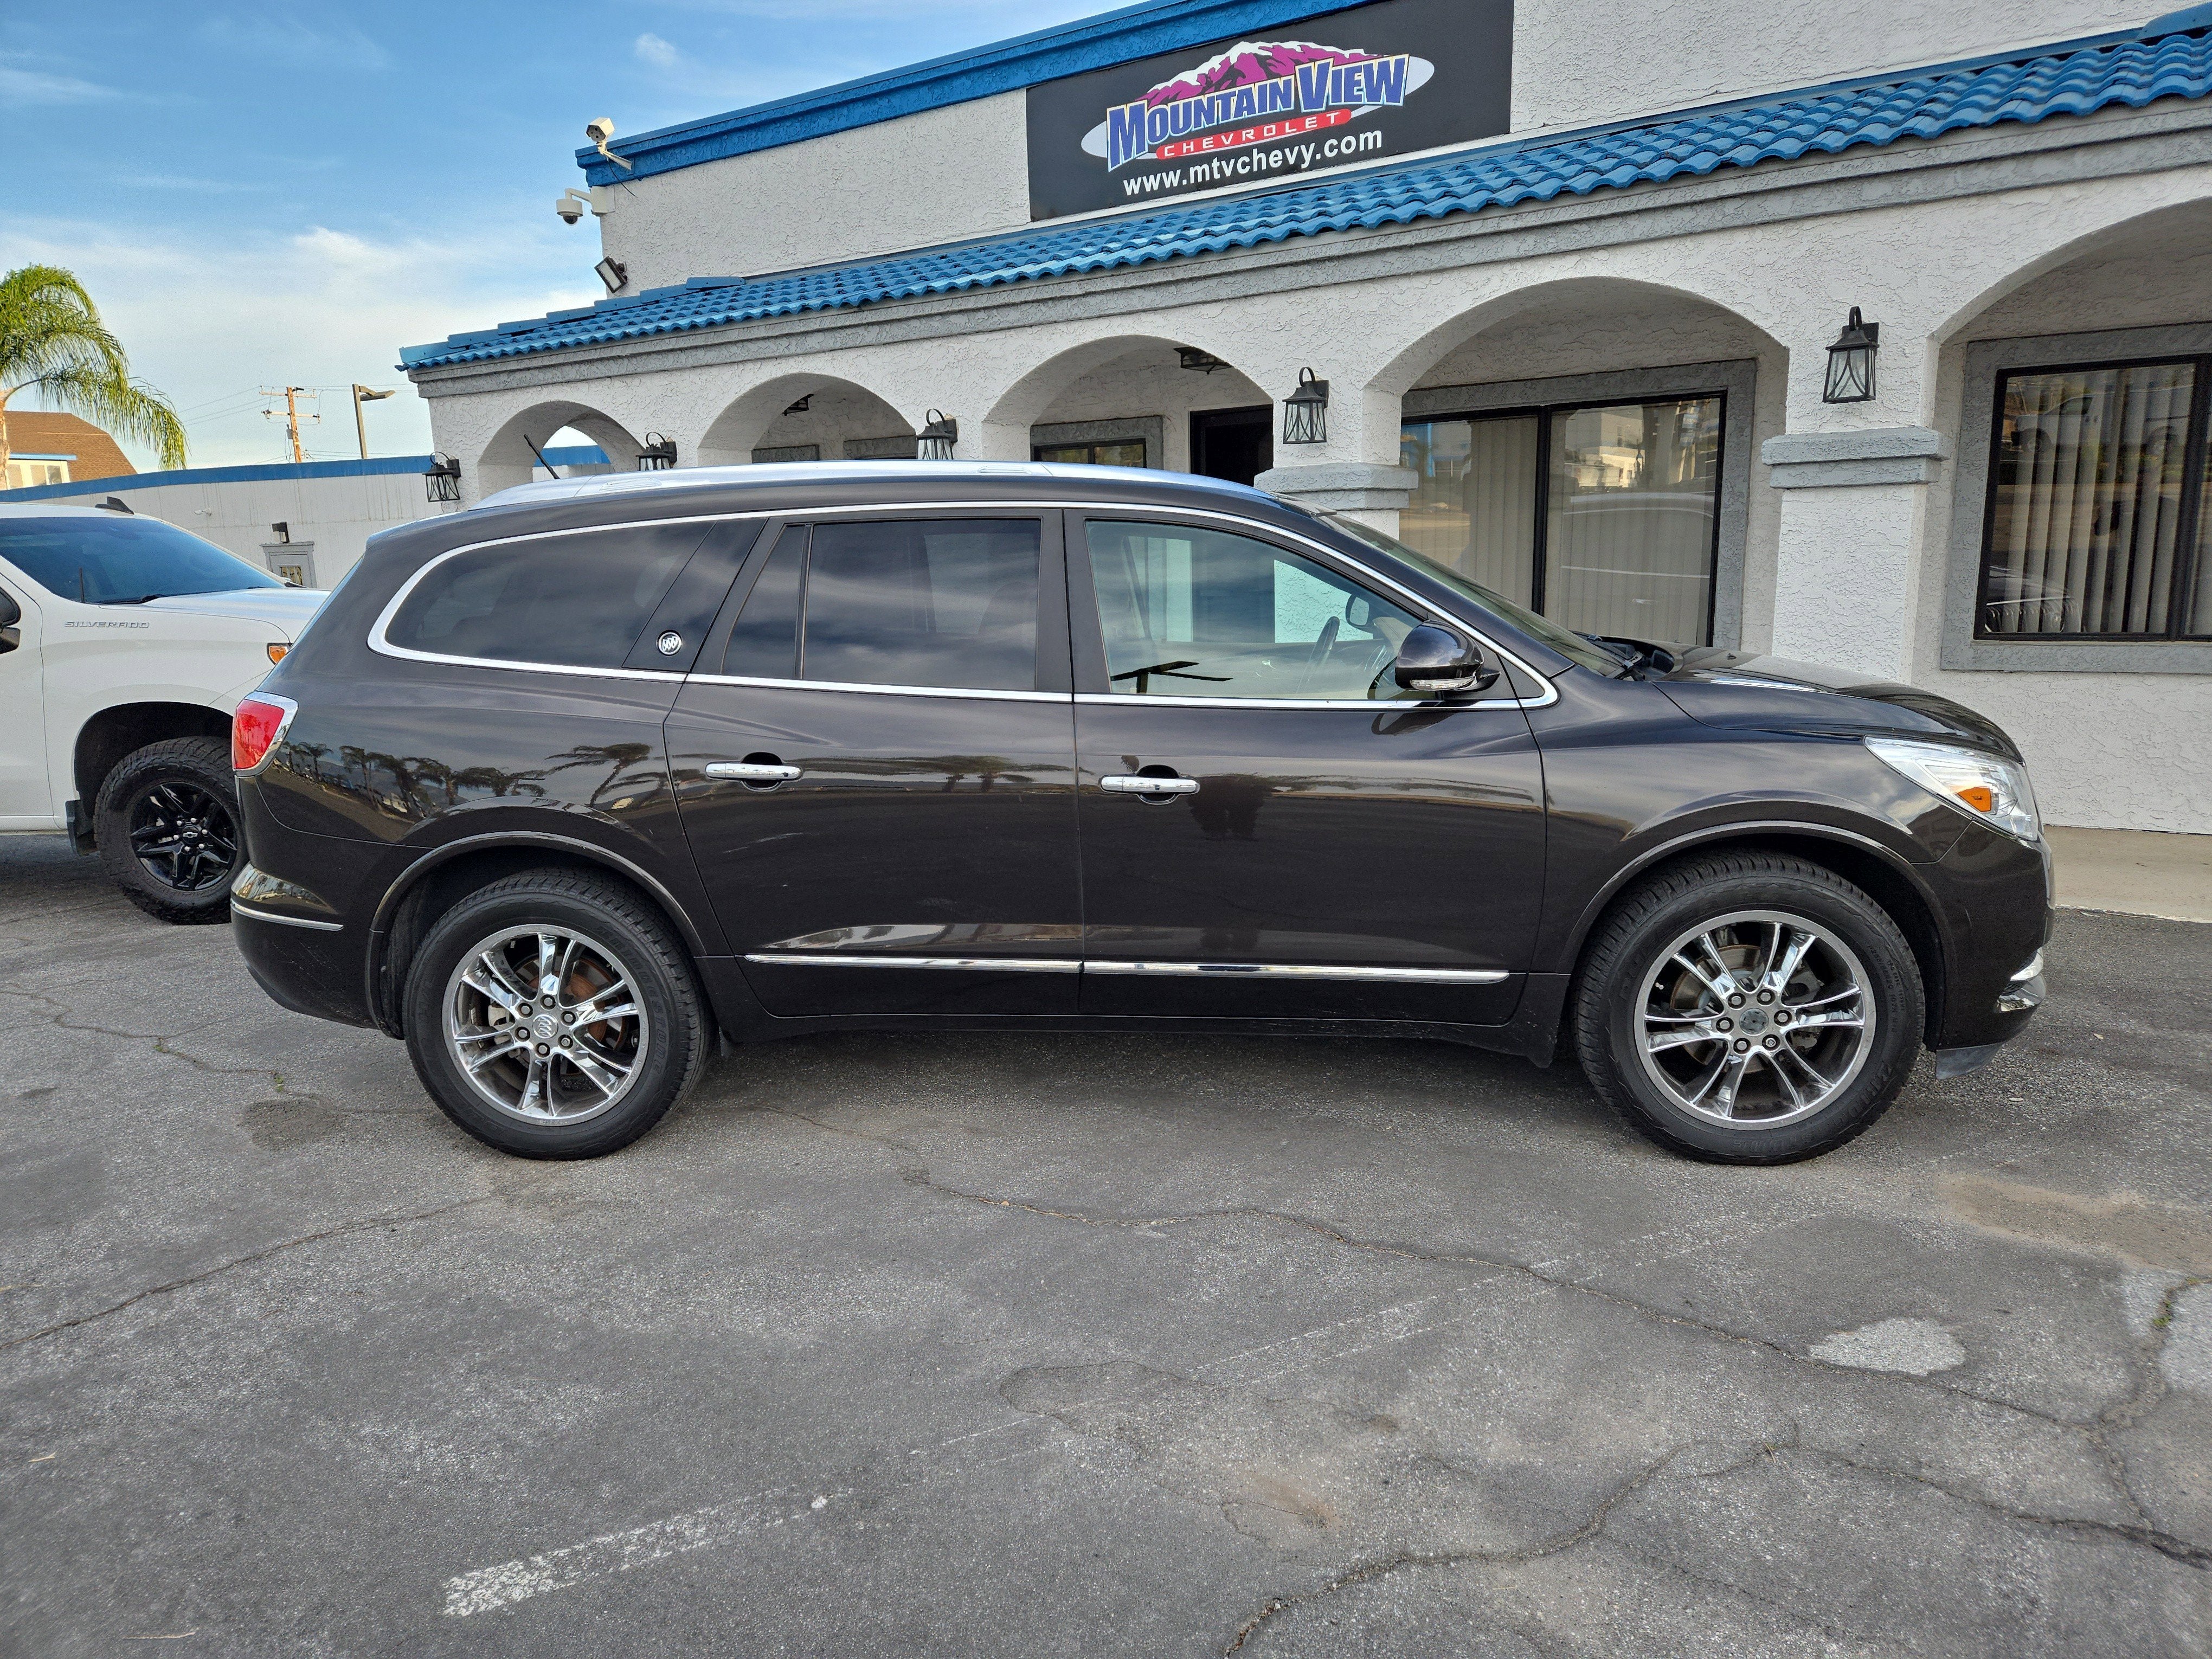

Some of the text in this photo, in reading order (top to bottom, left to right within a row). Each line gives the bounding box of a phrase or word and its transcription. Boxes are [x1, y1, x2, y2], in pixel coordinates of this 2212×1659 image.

[1108, 54, 1410, 170] MOUNTAIN VIEW
[1162, 112, 1339, 158] CHEVROLET
[1124, 128, 1382, 196] www.mtvchevy.com
